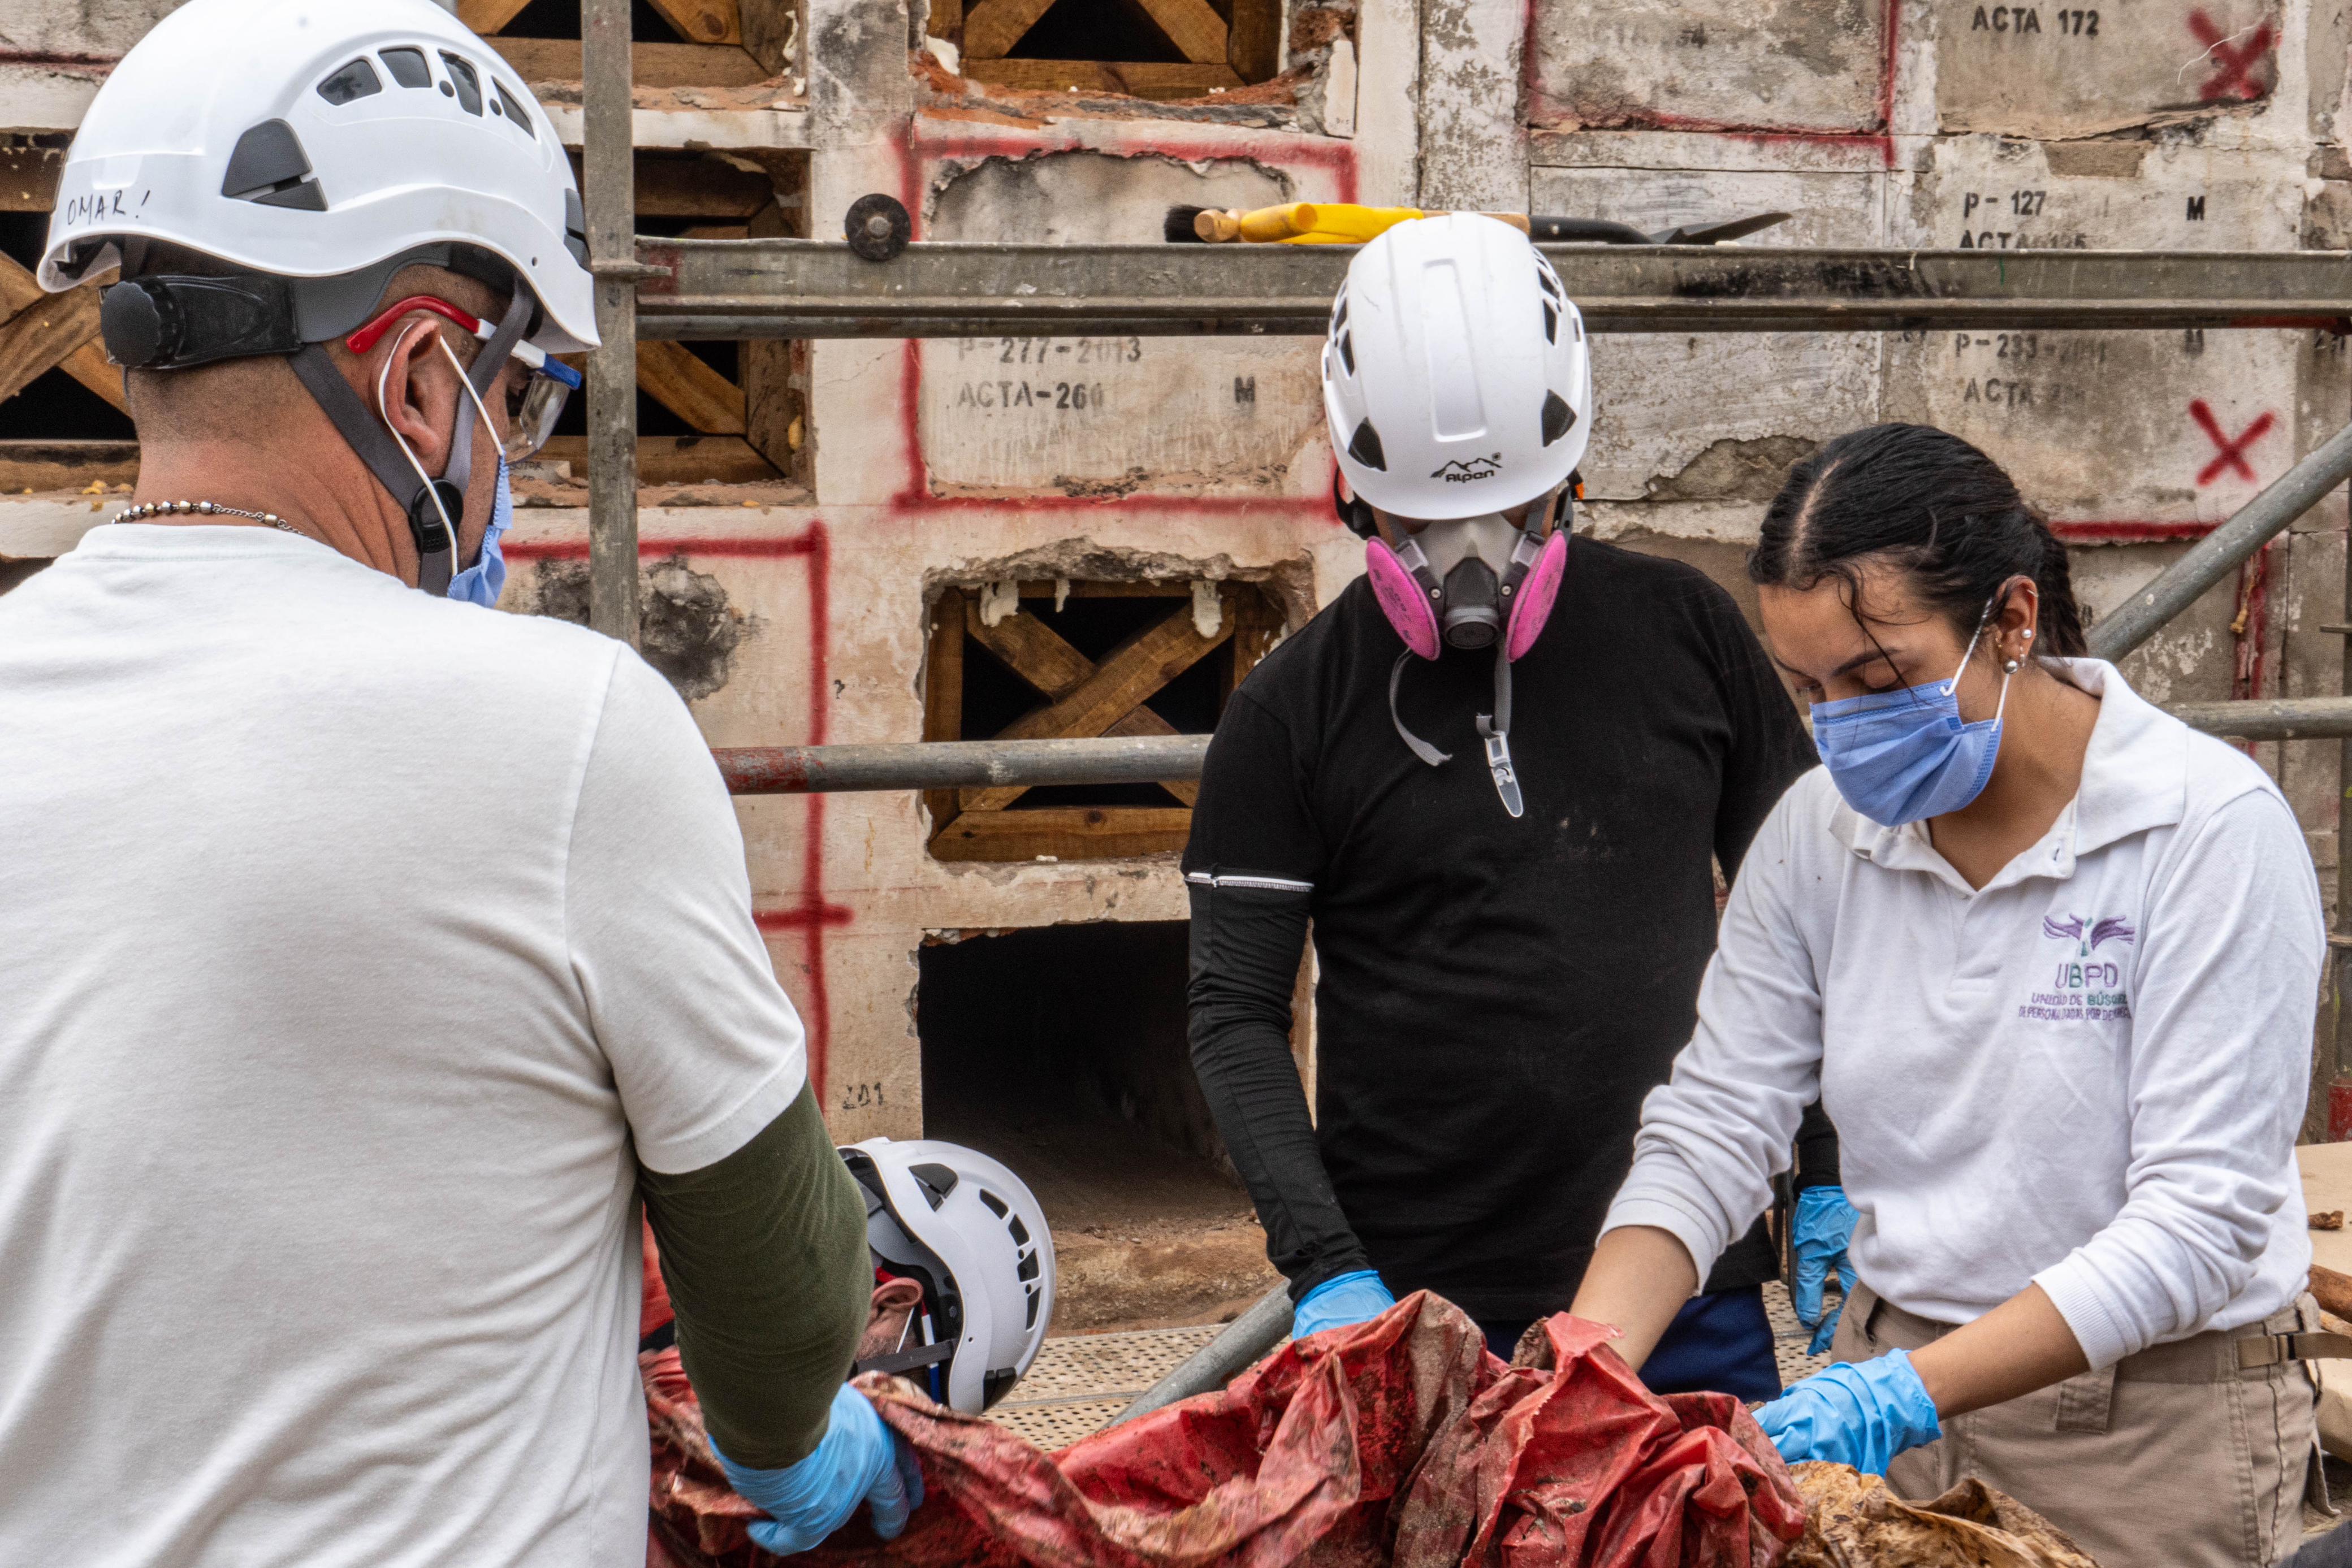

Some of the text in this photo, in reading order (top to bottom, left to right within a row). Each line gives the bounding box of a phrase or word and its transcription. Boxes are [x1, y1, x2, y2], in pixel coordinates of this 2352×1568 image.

[1971, 5, 2099, 37] ACTA 172
[2186, 196, 2205, 220] M
[1446, 470, 1494, 483] Alpen
[2055, 963, 2118, 988] UBPD
